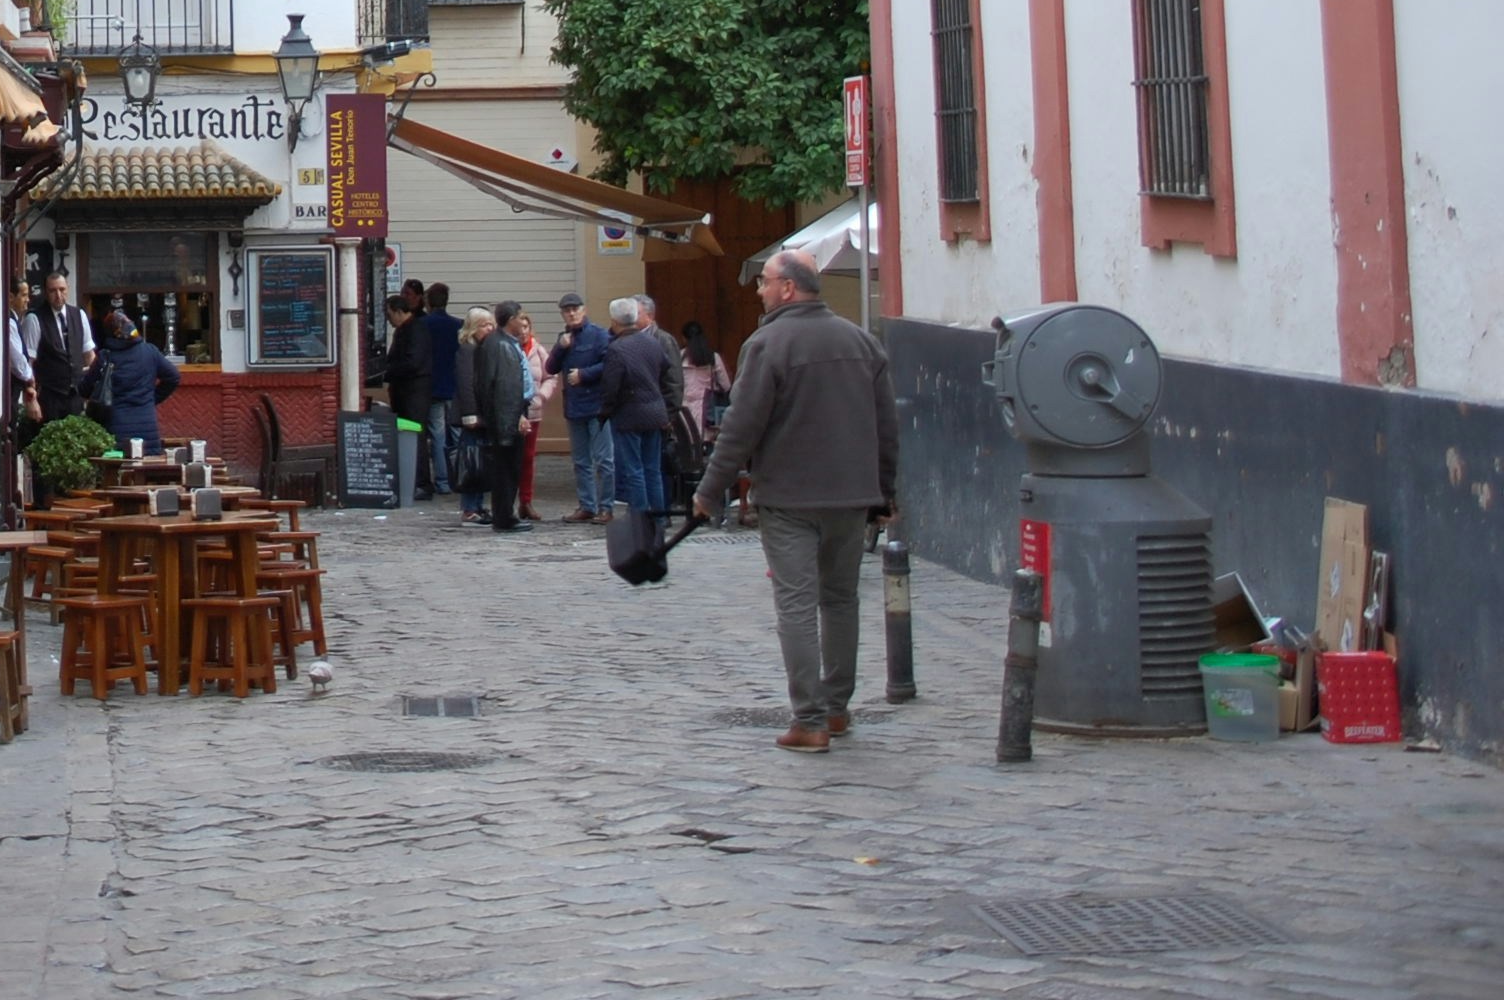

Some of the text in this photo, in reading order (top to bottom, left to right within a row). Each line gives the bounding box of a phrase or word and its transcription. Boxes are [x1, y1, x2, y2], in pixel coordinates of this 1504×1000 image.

[64, 95, 284, 141] Restaurante
[347, 144, 355, 165] Juan
[330, 111, 344, 227] CASUAL SEVILLA
[347, 166, 355, 185] Don
[295, 205, 326, 218] BAR
